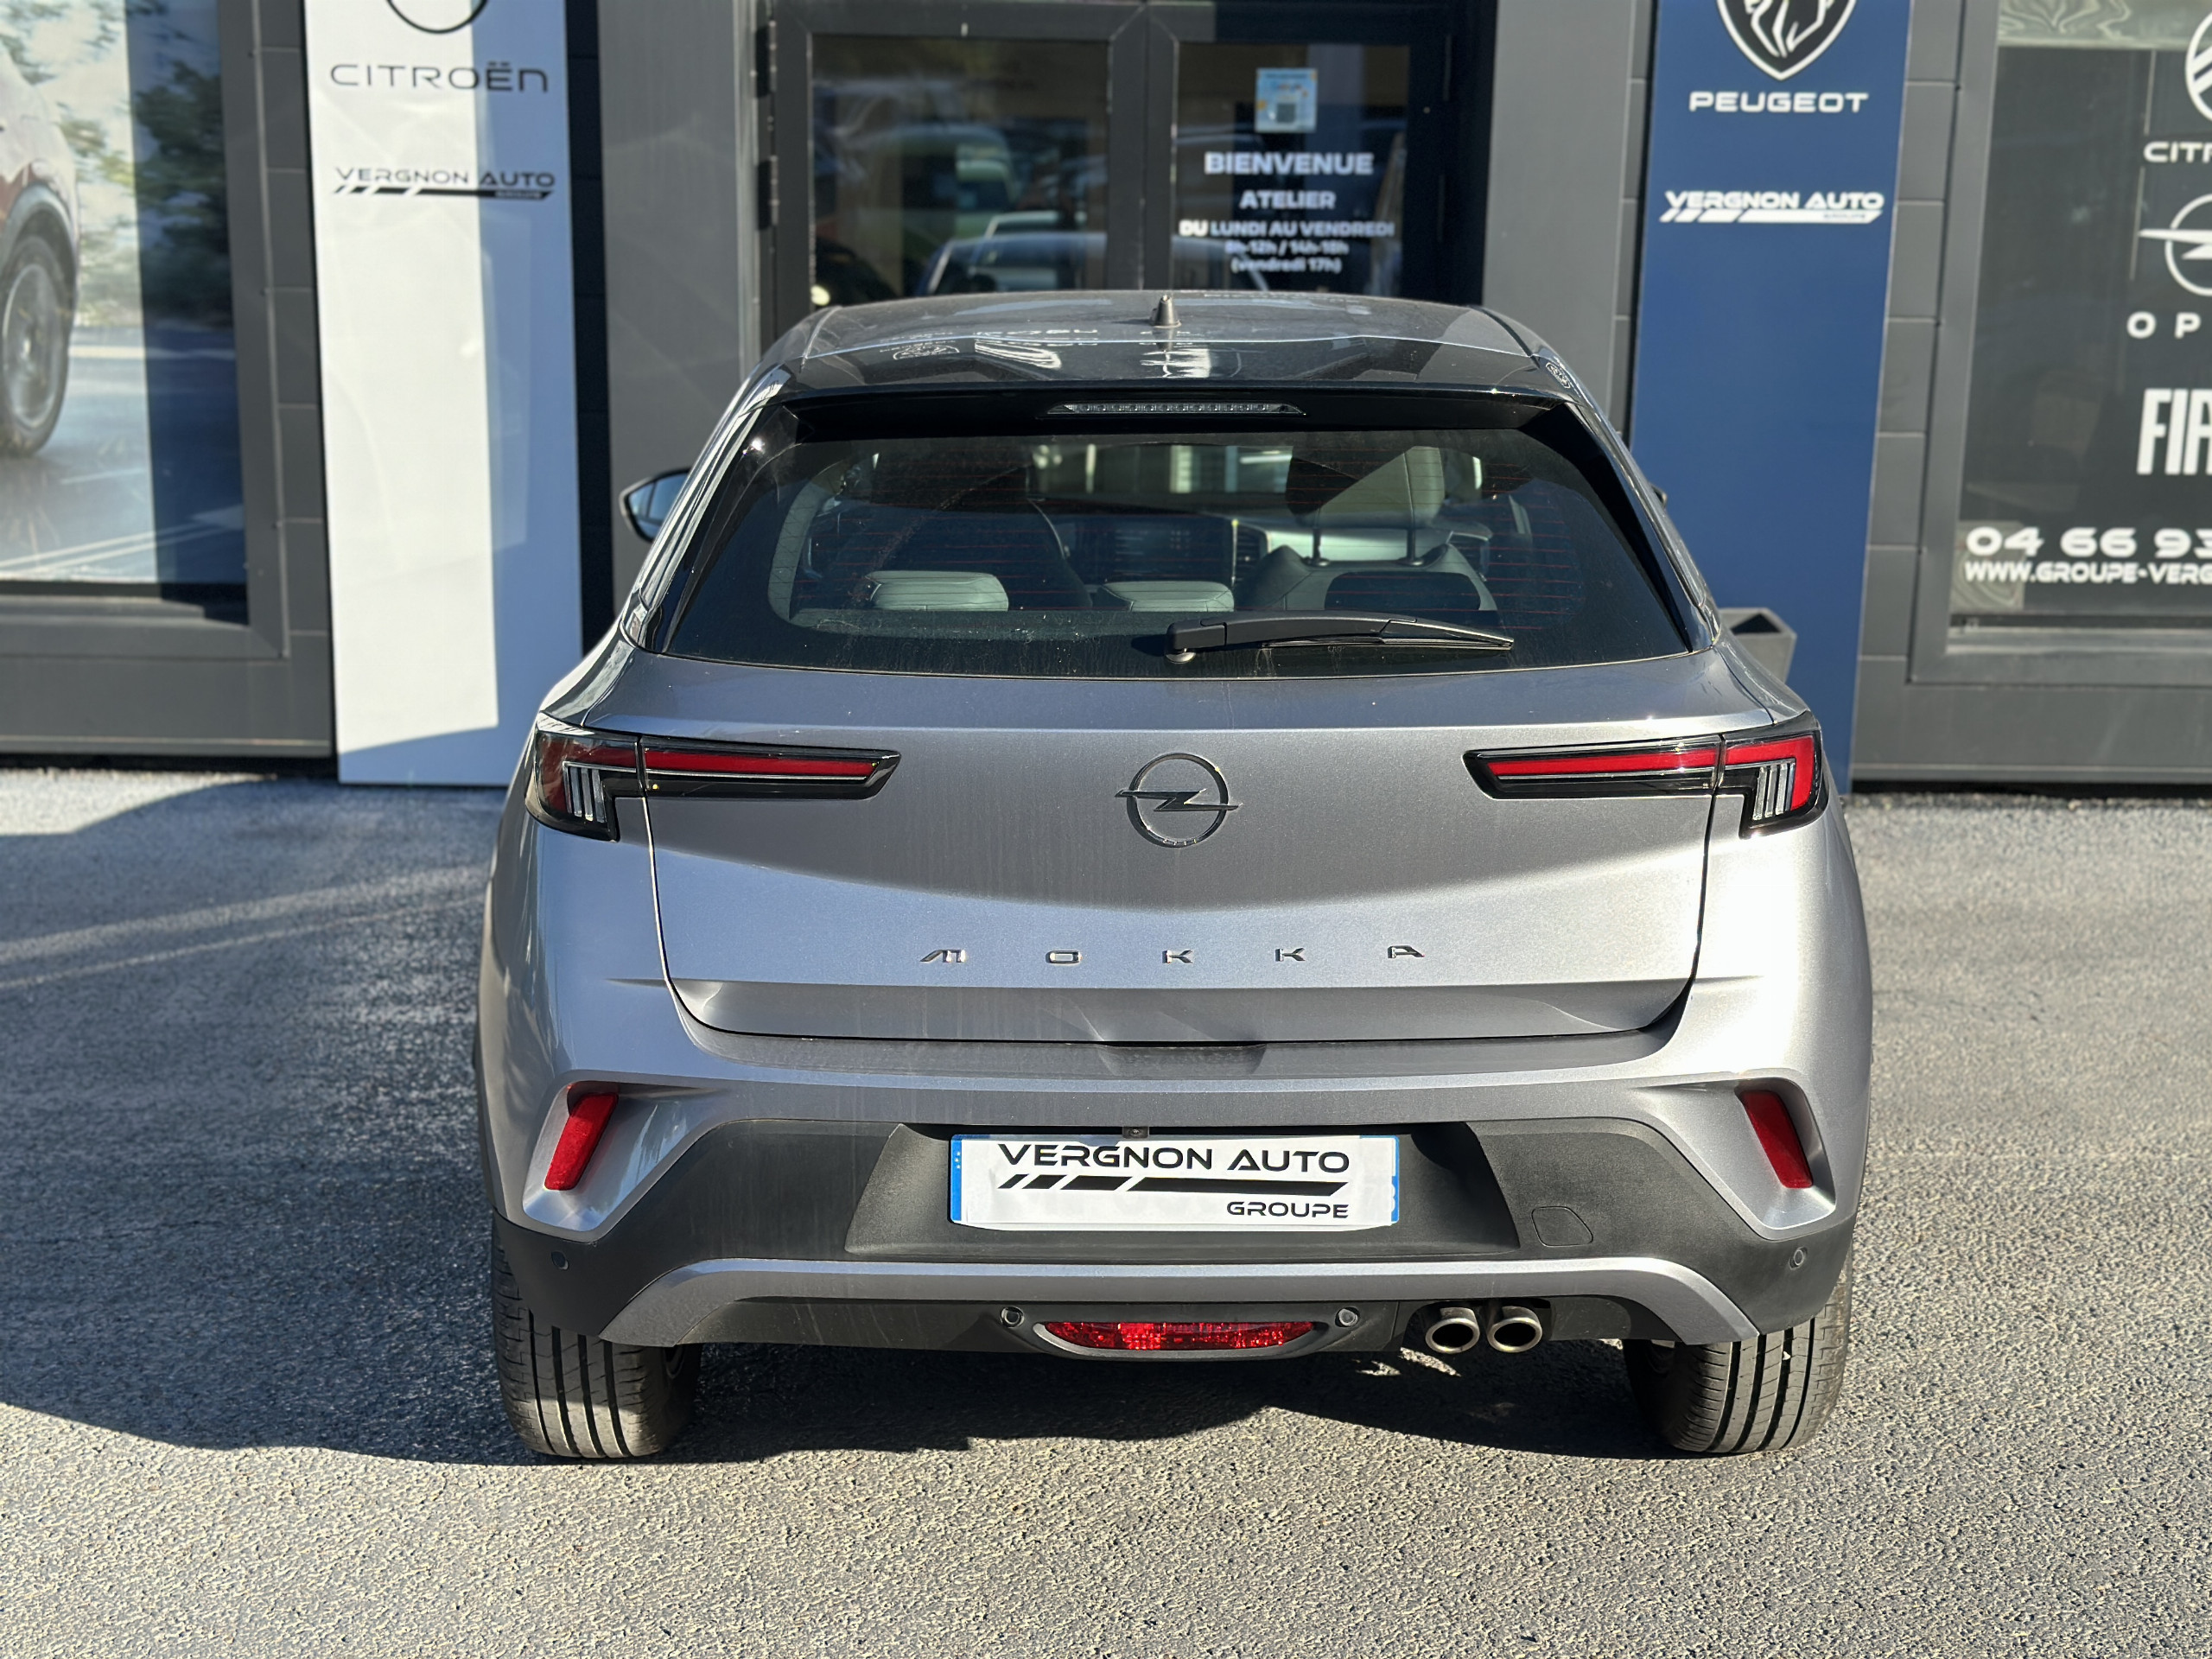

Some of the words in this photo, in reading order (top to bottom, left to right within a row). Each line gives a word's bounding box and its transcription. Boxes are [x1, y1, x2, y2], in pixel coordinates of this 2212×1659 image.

[1689, 92, 1868, 112] PEUGEOT
[1205, 151, 1374, 175] BIENVENUE
[334, 167, 468, 184] VERGNON
[480, 171, 556, 188] AUTO
[1239, 190, 1337, 210] ATELIER
[1664, 191, 1800, 210] VERGNON
[1804, 192, 1885, 210] AUTO
[1179, 219, 1208, 237] DU
[1210, 221, 1267, 237] LUNDI
[1269, 221, 1297, 237] AU
[1300, 221, 1395, 237] VENDREDI
[2136, 388, 2212, 475] FIA
[1966, 525, 2044, 556] 04
[2060, 527, 2137, 558] 66
[997, 1143, 1212, 1170] VERGNON
[1226, 1148, 1350, 1173] AUTO
[1226, 1201, 1349, 1219] GROUPE
